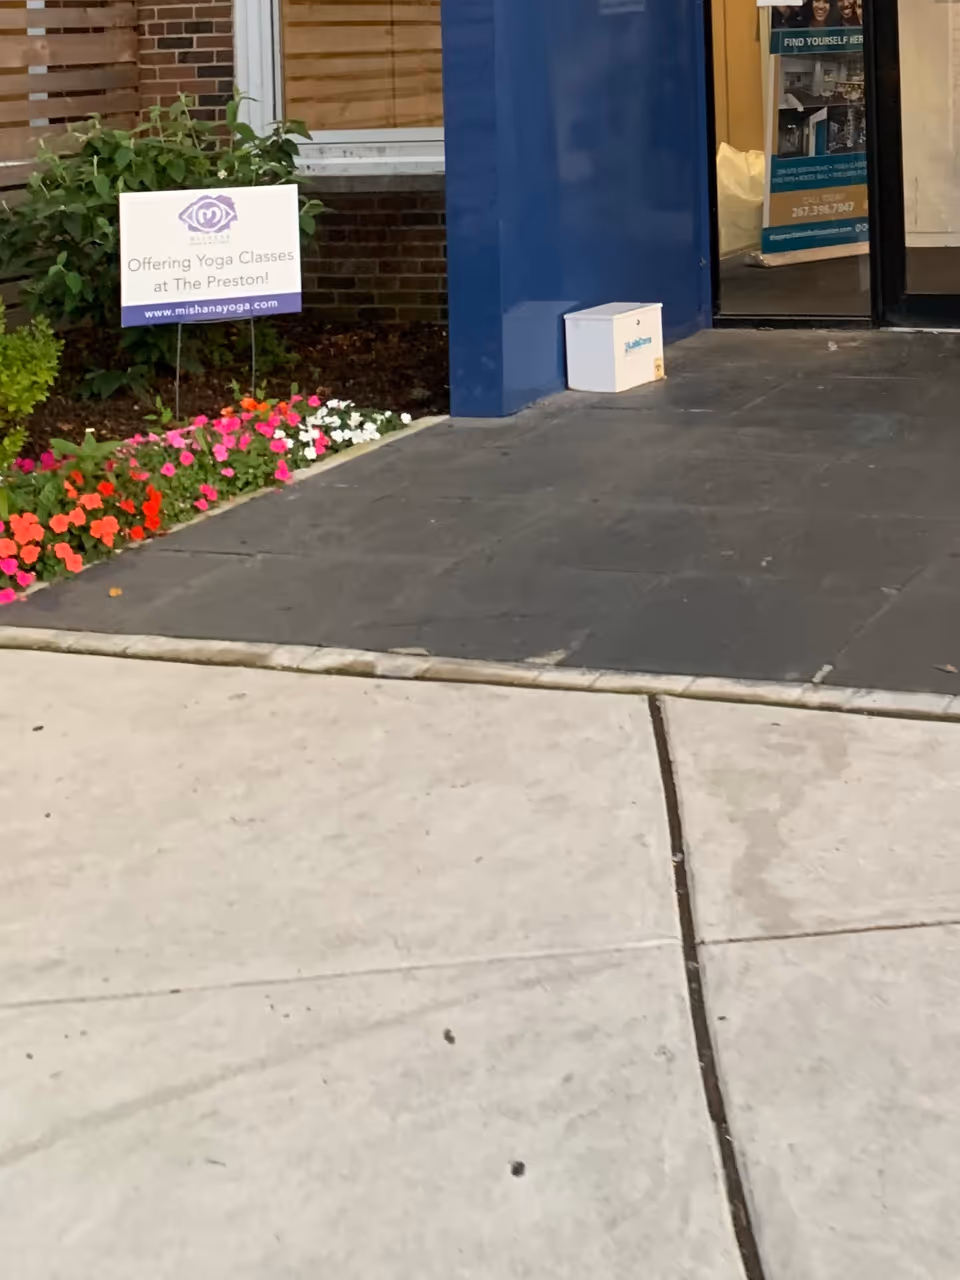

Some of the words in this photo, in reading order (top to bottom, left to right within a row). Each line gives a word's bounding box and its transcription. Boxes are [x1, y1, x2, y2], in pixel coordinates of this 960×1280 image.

[784, 38, 804, 47] FIND
[806, 36, 848, 46] YOURSELF
[127, 256, 191, 272] Offering
[196, 254, 234, 269] Yoga
[238, 250, 295, 265] Classes
[154, 280, 168, 293] at
[173, 278, 201, 292] The
[207, 272, 269, 289] Preston!
[144, 300, 278, 318] www.mishanayoga.com
